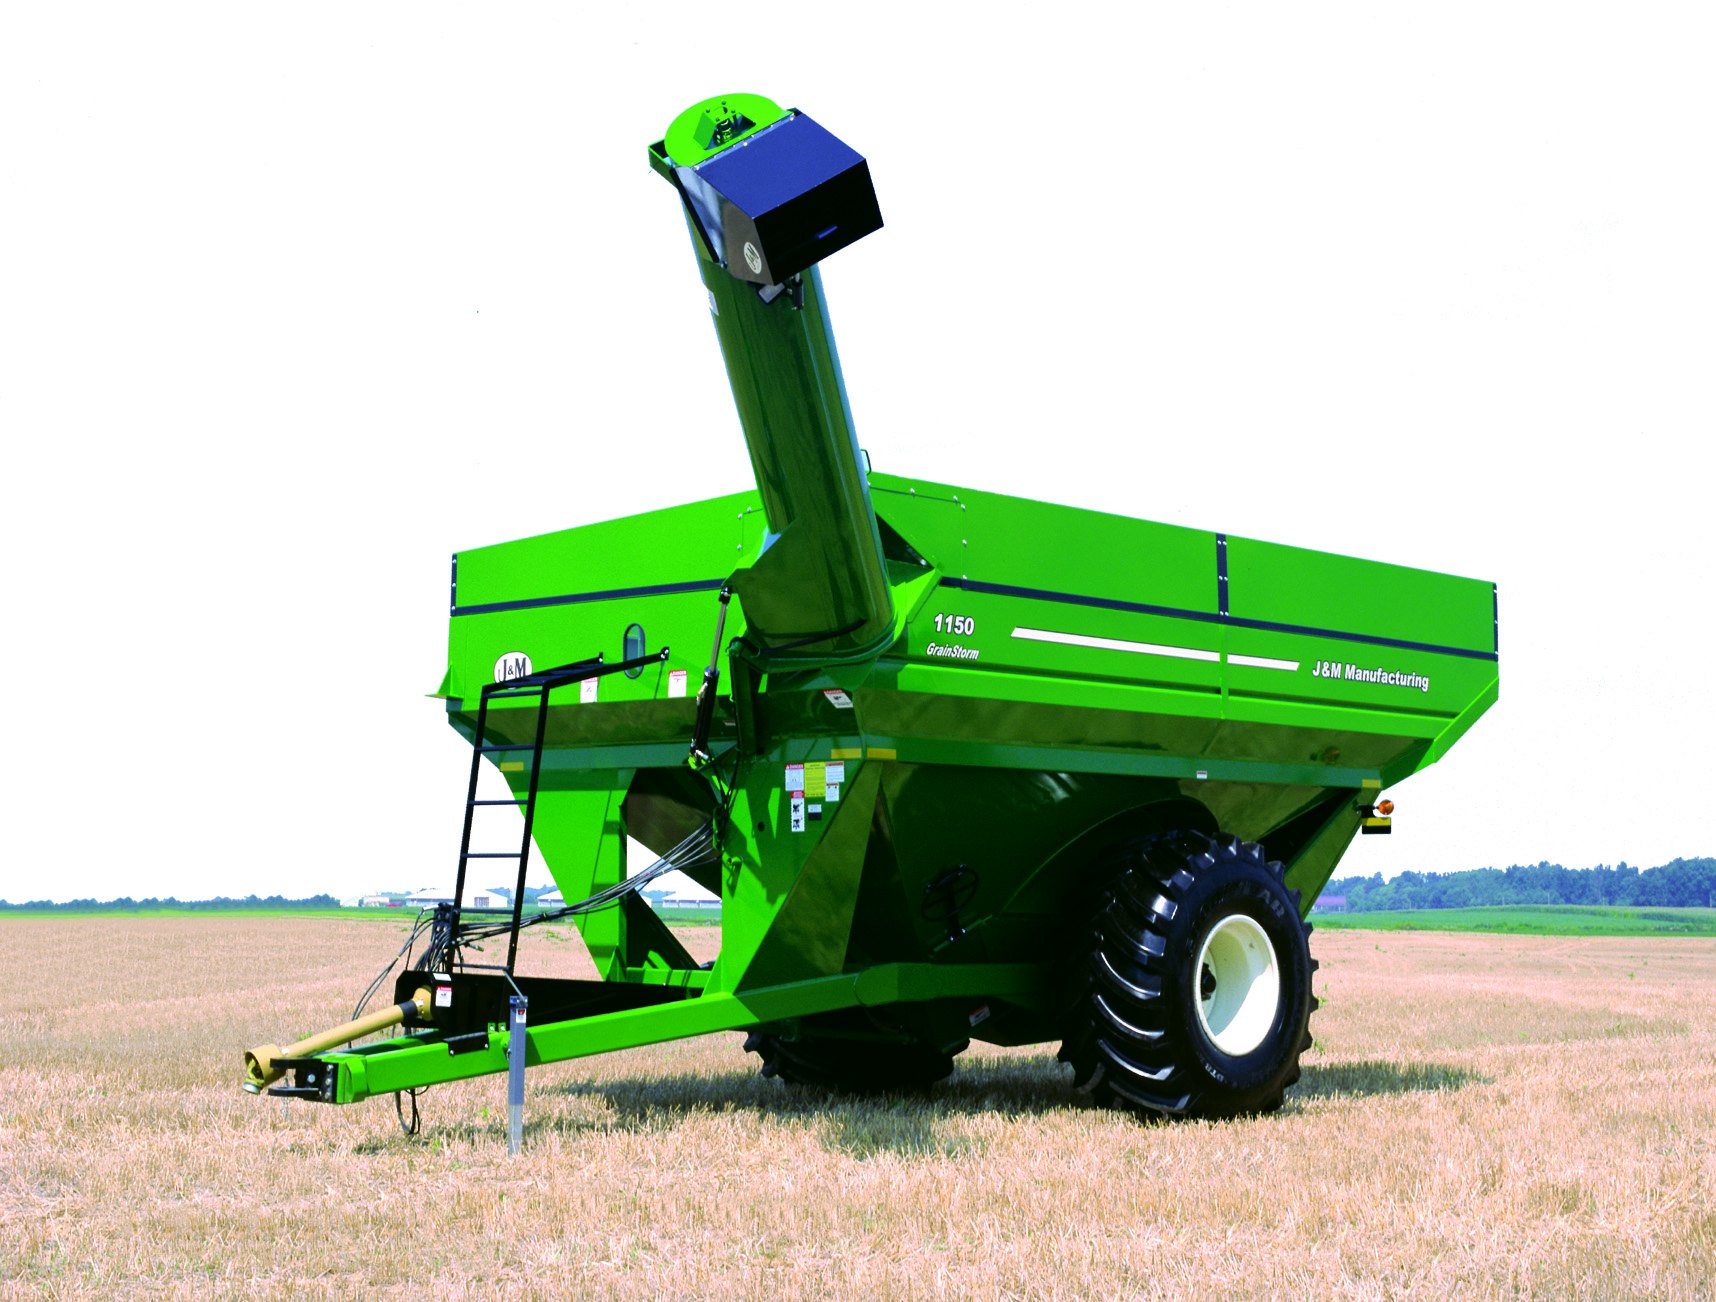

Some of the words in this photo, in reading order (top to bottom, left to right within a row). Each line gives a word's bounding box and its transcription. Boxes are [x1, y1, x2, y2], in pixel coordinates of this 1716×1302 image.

[934, 612, 975, 636] 1150
[926, 642, 980, 660] GrainStorm
[497, 657, 527, 682] J&M
[1312, 660, 1342, 679] J&M
[1344, 663, 1430, 693] Manufacturing
